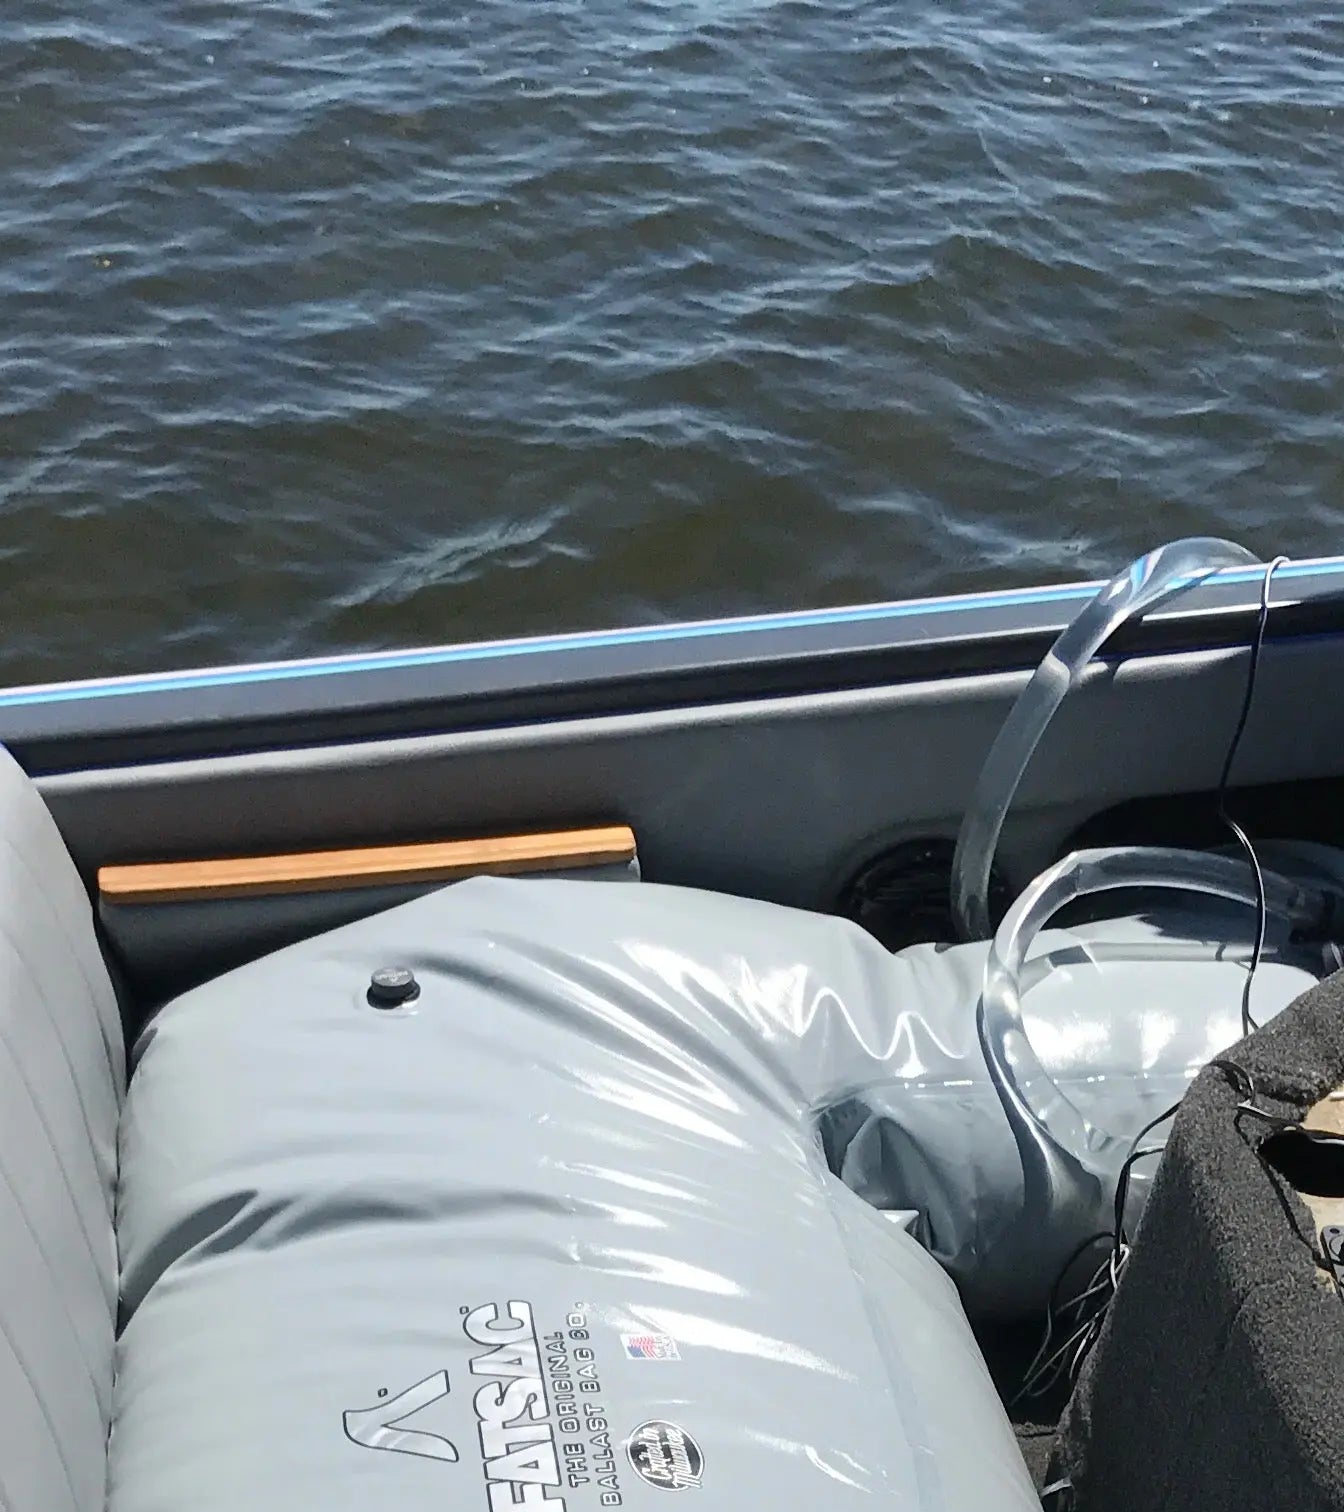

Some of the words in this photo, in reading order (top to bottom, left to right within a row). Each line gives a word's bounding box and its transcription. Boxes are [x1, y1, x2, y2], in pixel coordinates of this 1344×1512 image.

[543, 1331, 578, 1433] ORIGINAL
[573, 1347, 601, 1393] BAG
[566, 1440, 587, 1488] THE
[583, 1402, 623, 1507] BALLAST
[639, 1441, 672, 1480] Crafted
[662, 1429, 703, 1488] Milwaukee
